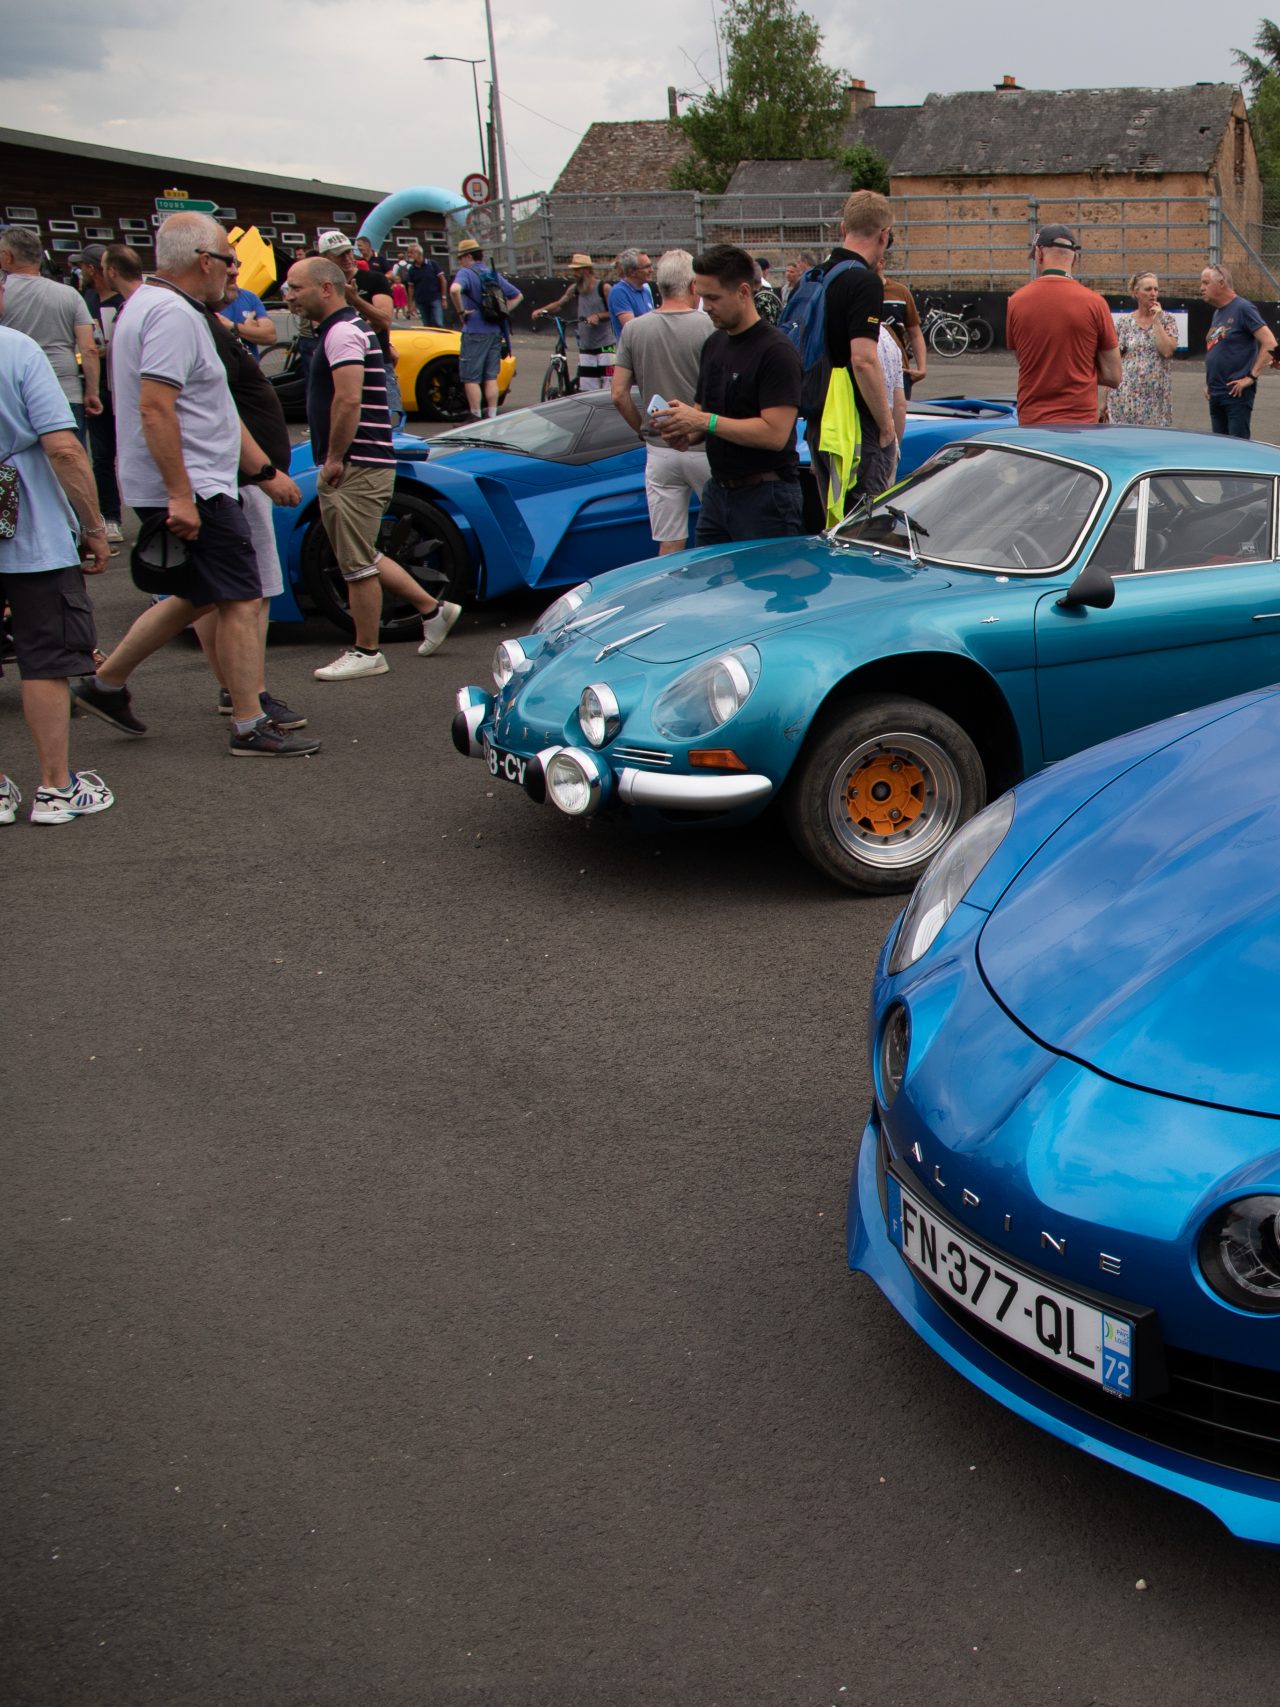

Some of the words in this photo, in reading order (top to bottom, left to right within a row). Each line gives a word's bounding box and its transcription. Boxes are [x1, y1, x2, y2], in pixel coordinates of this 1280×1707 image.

[911, 1141, 1122, 1276] ALPINE
[902, 1197, 1096, 1370] FN-377-QL
[1104, 1353, 1130, 1389] 72
